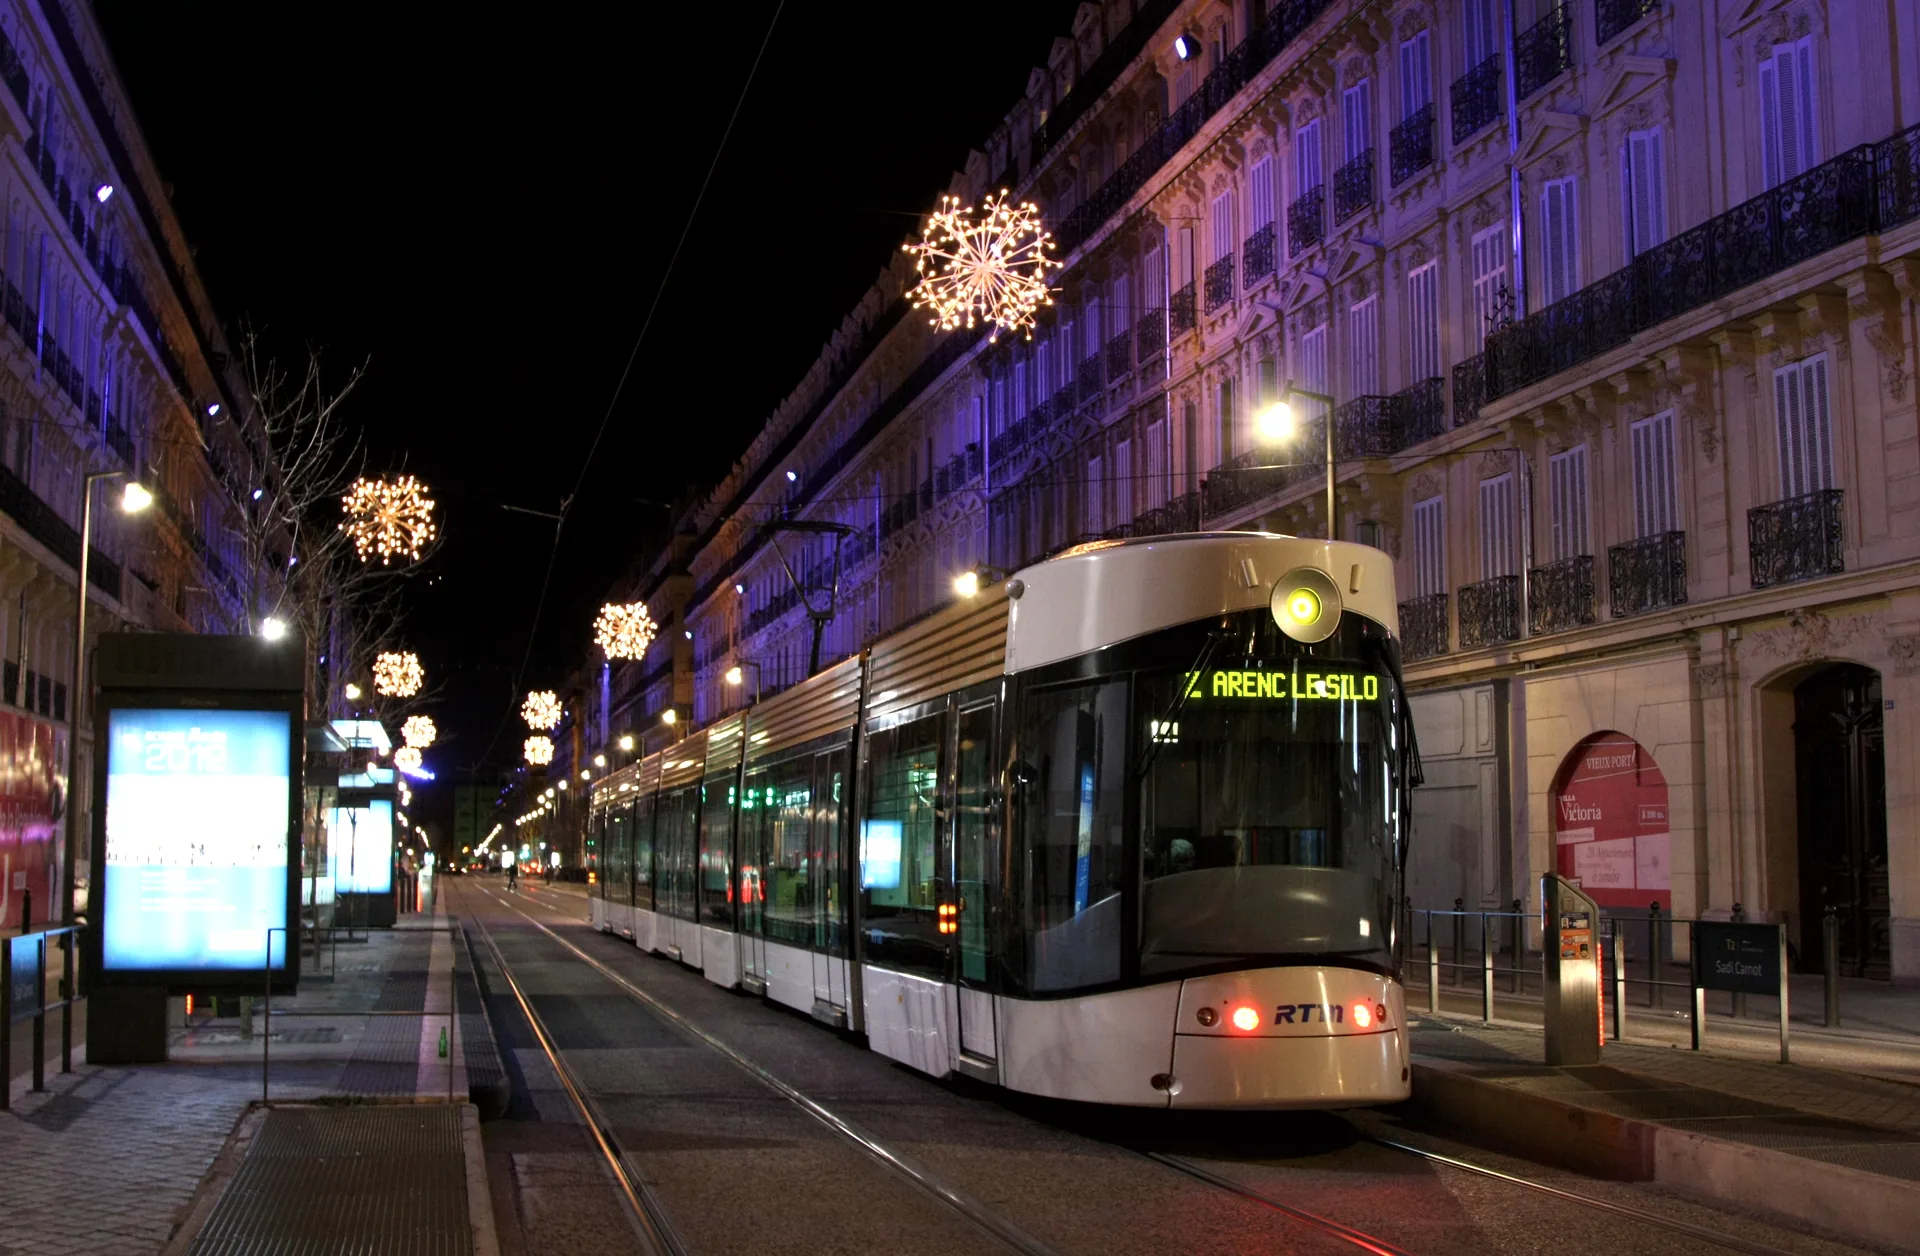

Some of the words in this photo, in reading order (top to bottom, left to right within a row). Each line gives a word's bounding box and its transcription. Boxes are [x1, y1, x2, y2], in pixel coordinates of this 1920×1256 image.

[1213, 671, 1286, 697] ARENC
[1292, 673, 1321, 699] LE
[1325, 674, 1378, 700] SILO
[1560, 798, 1602, 821] Victoria
[1715, 960, 1734, 974] Sadi
[1735, 961, 1763, 977] Carnot
